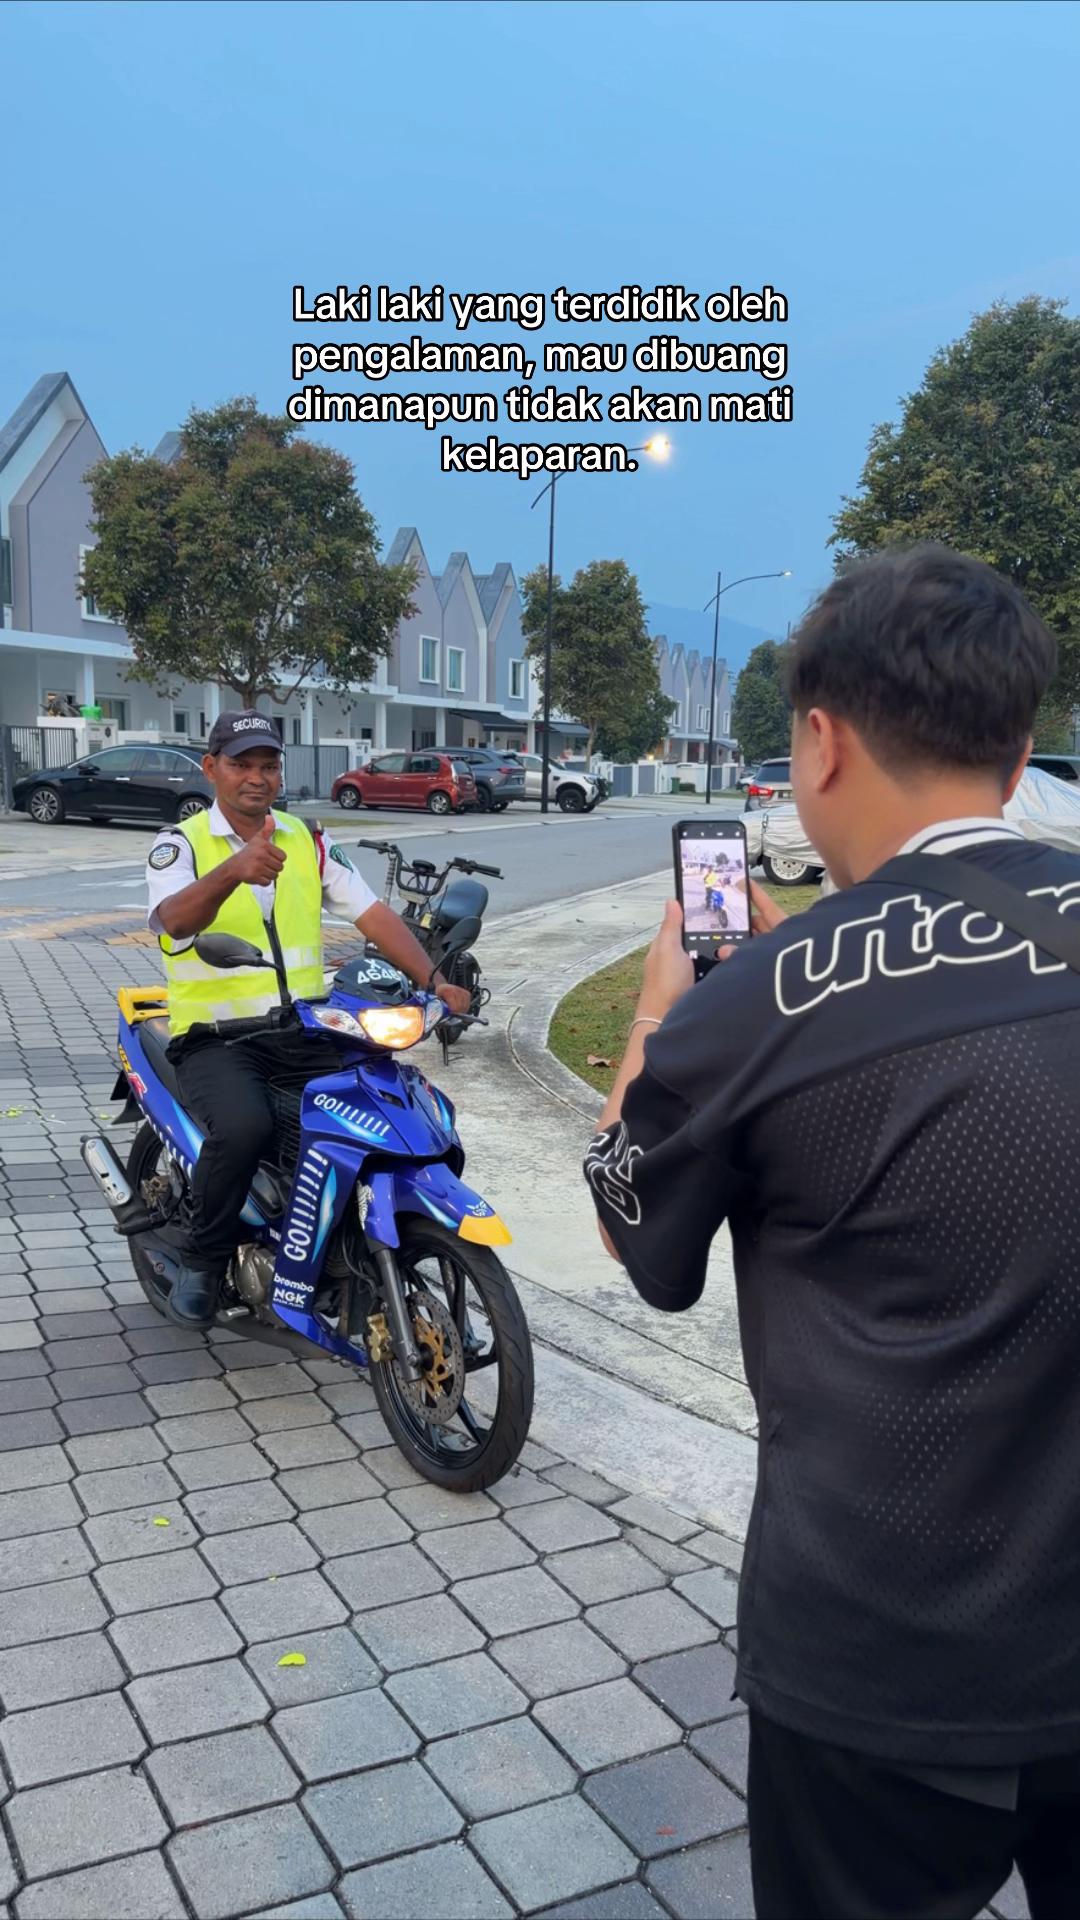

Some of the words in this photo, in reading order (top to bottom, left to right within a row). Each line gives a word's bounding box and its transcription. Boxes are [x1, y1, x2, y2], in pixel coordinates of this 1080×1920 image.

[232, 717, 272, 732] SECURITY
[273, 1272, 315, 1293] brembo
[273, 1287, 307, 1305] NGK
